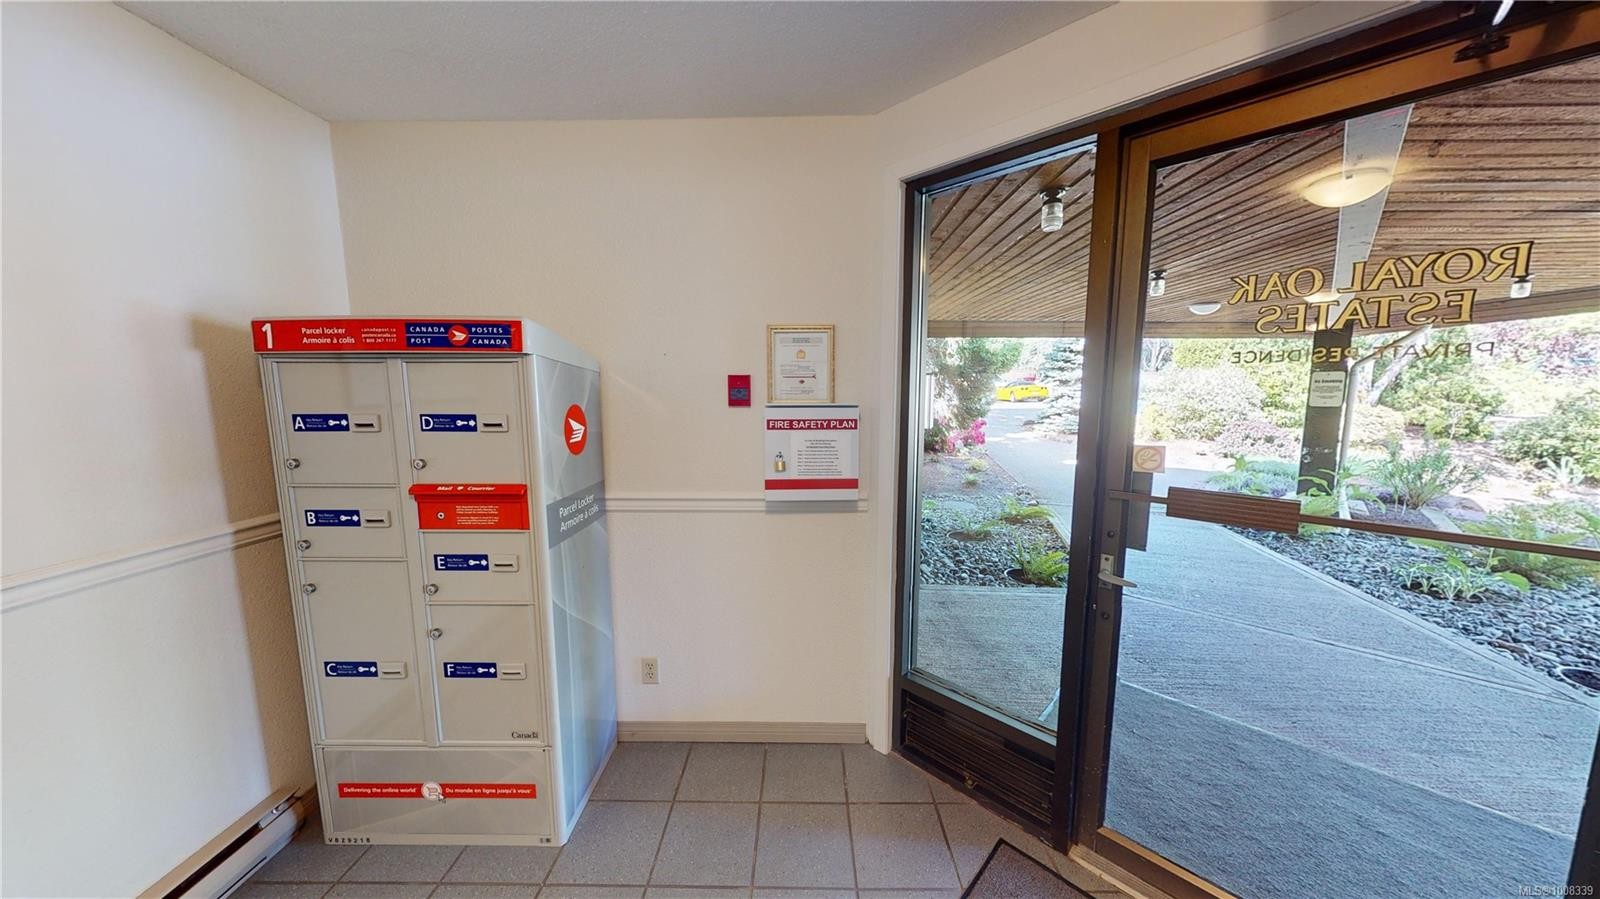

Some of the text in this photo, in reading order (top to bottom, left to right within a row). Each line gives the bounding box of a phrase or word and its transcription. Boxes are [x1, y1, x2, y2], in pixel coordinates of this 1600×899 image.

[261, 322, 273, 349] 1
[409, 325, 445, 333] CANADA
[302, 336, 355, 344] Armoire à colis
[295, 416, 306, 430] A
[422, 416, 434, 430] D
[769, 420, 855, 429] FIRE SAFETY PLAN
[560, 494, 594, 518] Parcel Locker
[306, 511, 316, 525] B
[560, 513, 584, 533] Armoire
[437, 556, 446, 569] E
[326, 663, 337, 676] C
[446, 663, 455, 676] F
[511, 731, 539, 739] Canada
